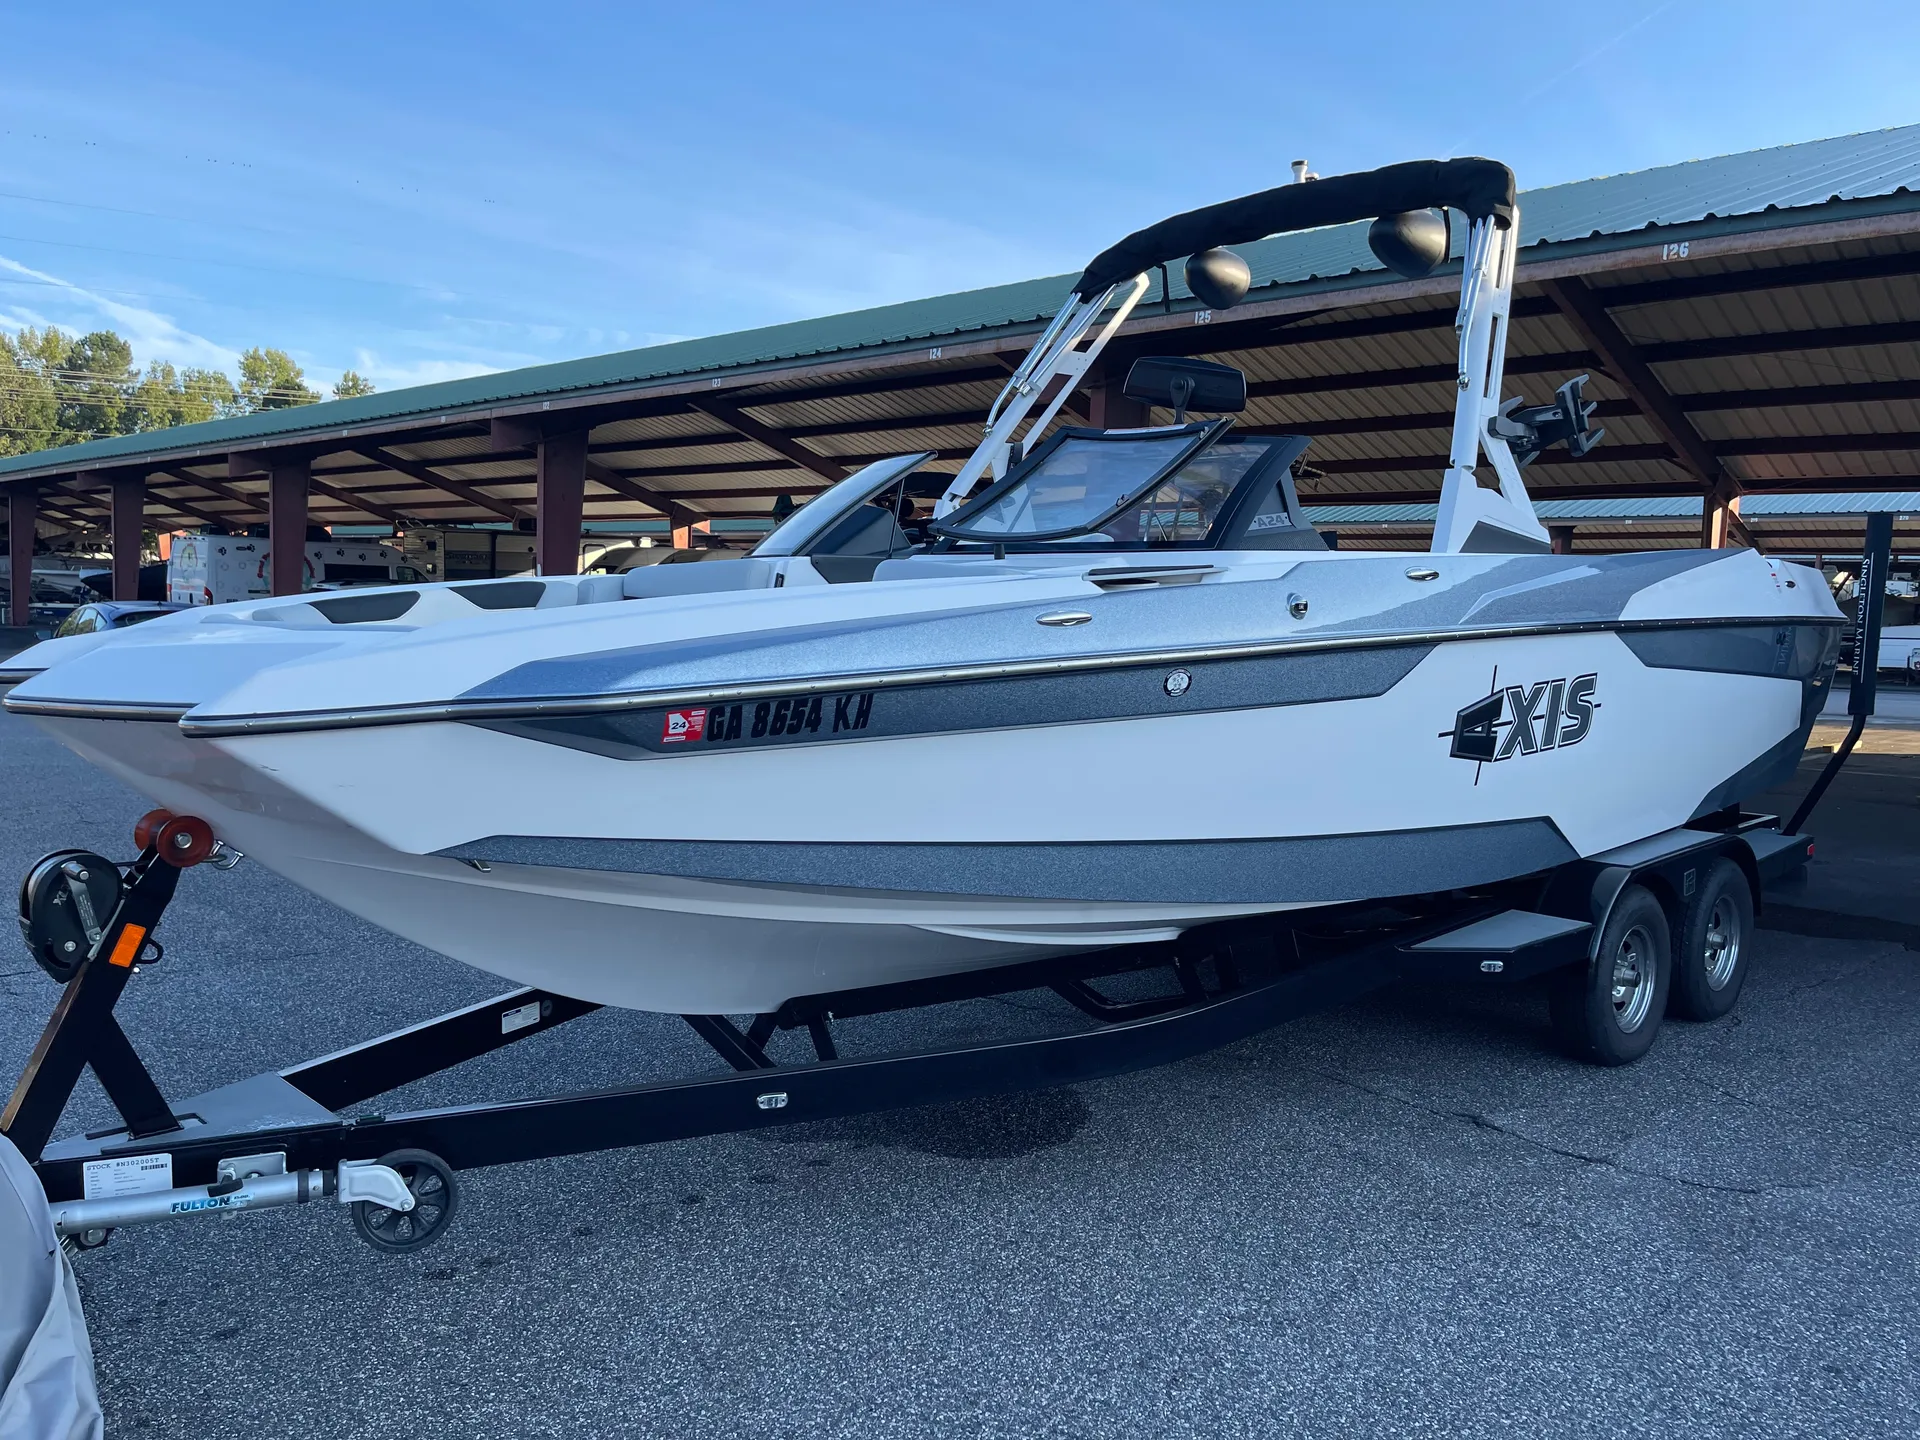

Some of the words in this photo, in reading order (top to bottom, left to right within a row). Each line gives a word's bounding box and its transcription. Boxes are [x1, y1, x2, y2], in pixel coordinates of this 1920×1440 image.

[1662, 242, 1690, 261] 126
[1194, 310, 1212, 325] 125
[929, 347, 942, 360] 124
[1257, 514, 1285, 527] A24
[707, 705, 743, 742] GA
[750, 697, 823, 739] 8654
[832, 693, 875, 733] KH
[1449, 671, 1598, 763] AXIS
[671, 721, 687, 730] 24
[86, 1163, 112, 1171] STOCK
[171, 1196, 231, 1213] FULTON
